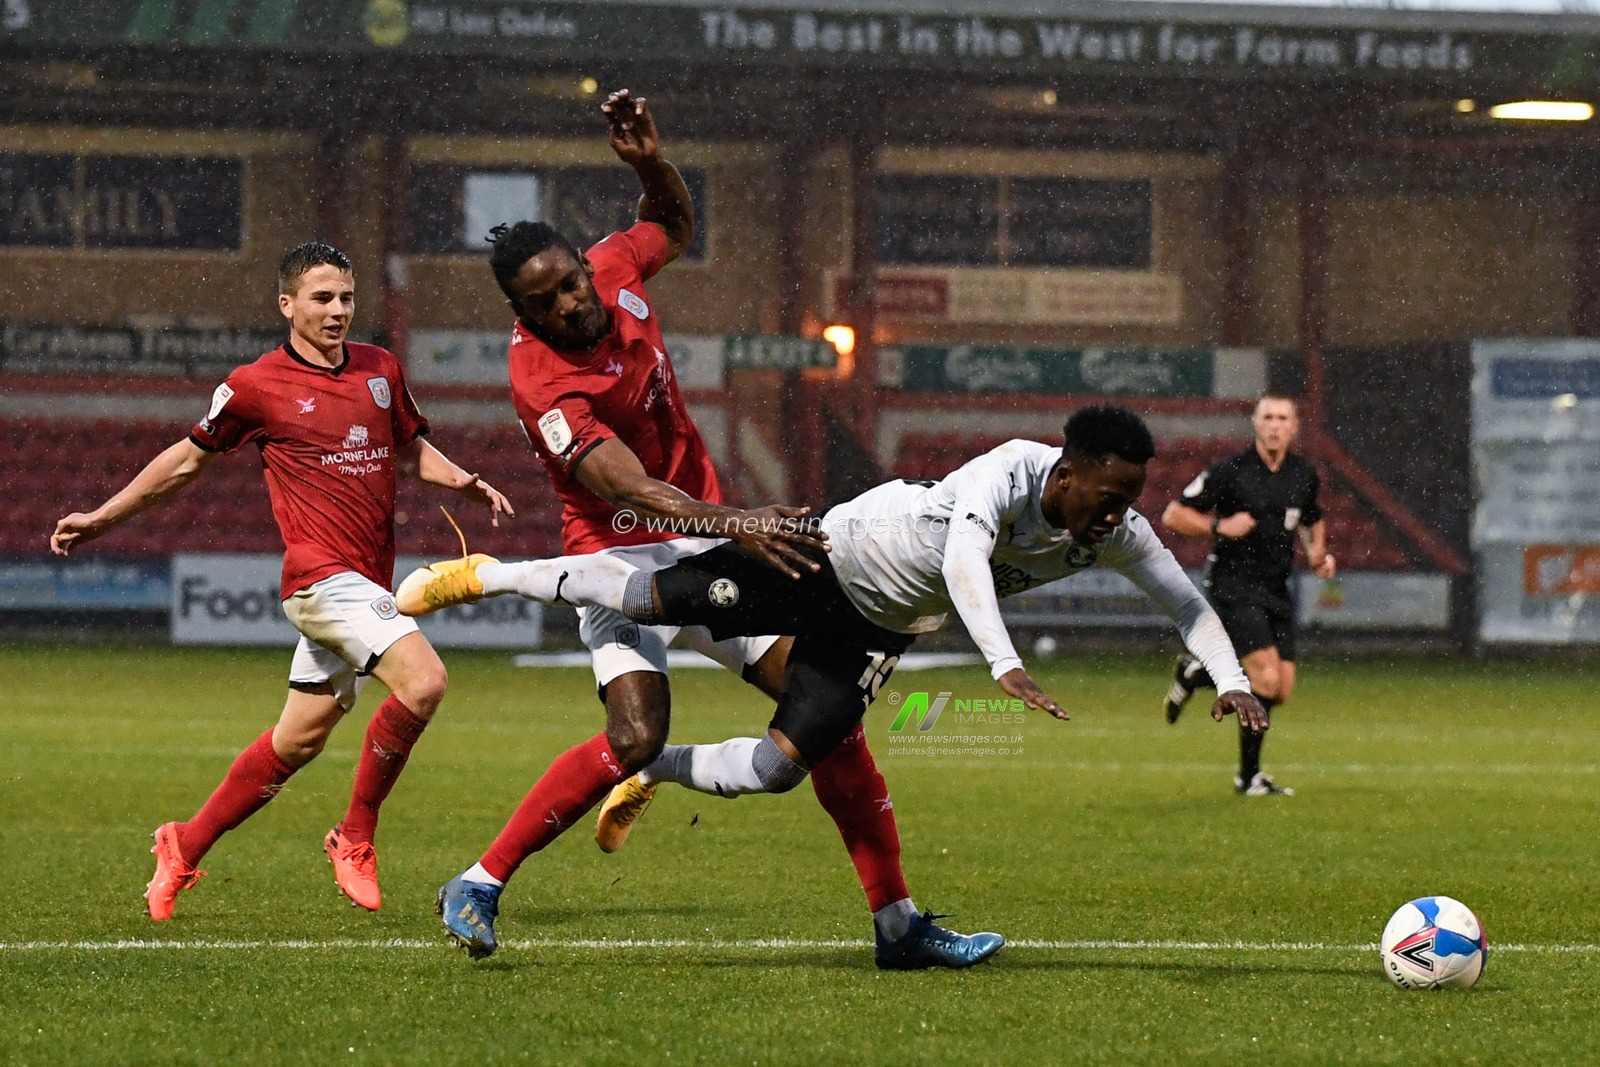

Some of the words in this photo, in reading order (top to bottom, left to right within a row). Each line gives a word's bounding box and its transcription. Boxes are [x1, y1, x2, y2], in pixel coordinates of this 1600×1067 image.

[702, 11, 775, 49] The
[794, 13, 883, 52] Best
[899, 16, 938, 54] in
[955, 18, 1023, 57] the
[1037, 23, 1142, 61] West
[1157, 25, 1218, 62] for
[1236, 28, 1340, 65] Farm
[321, 446, 389, 466] MORNFLAKE
[338, 465, 366, 476] Mighty
